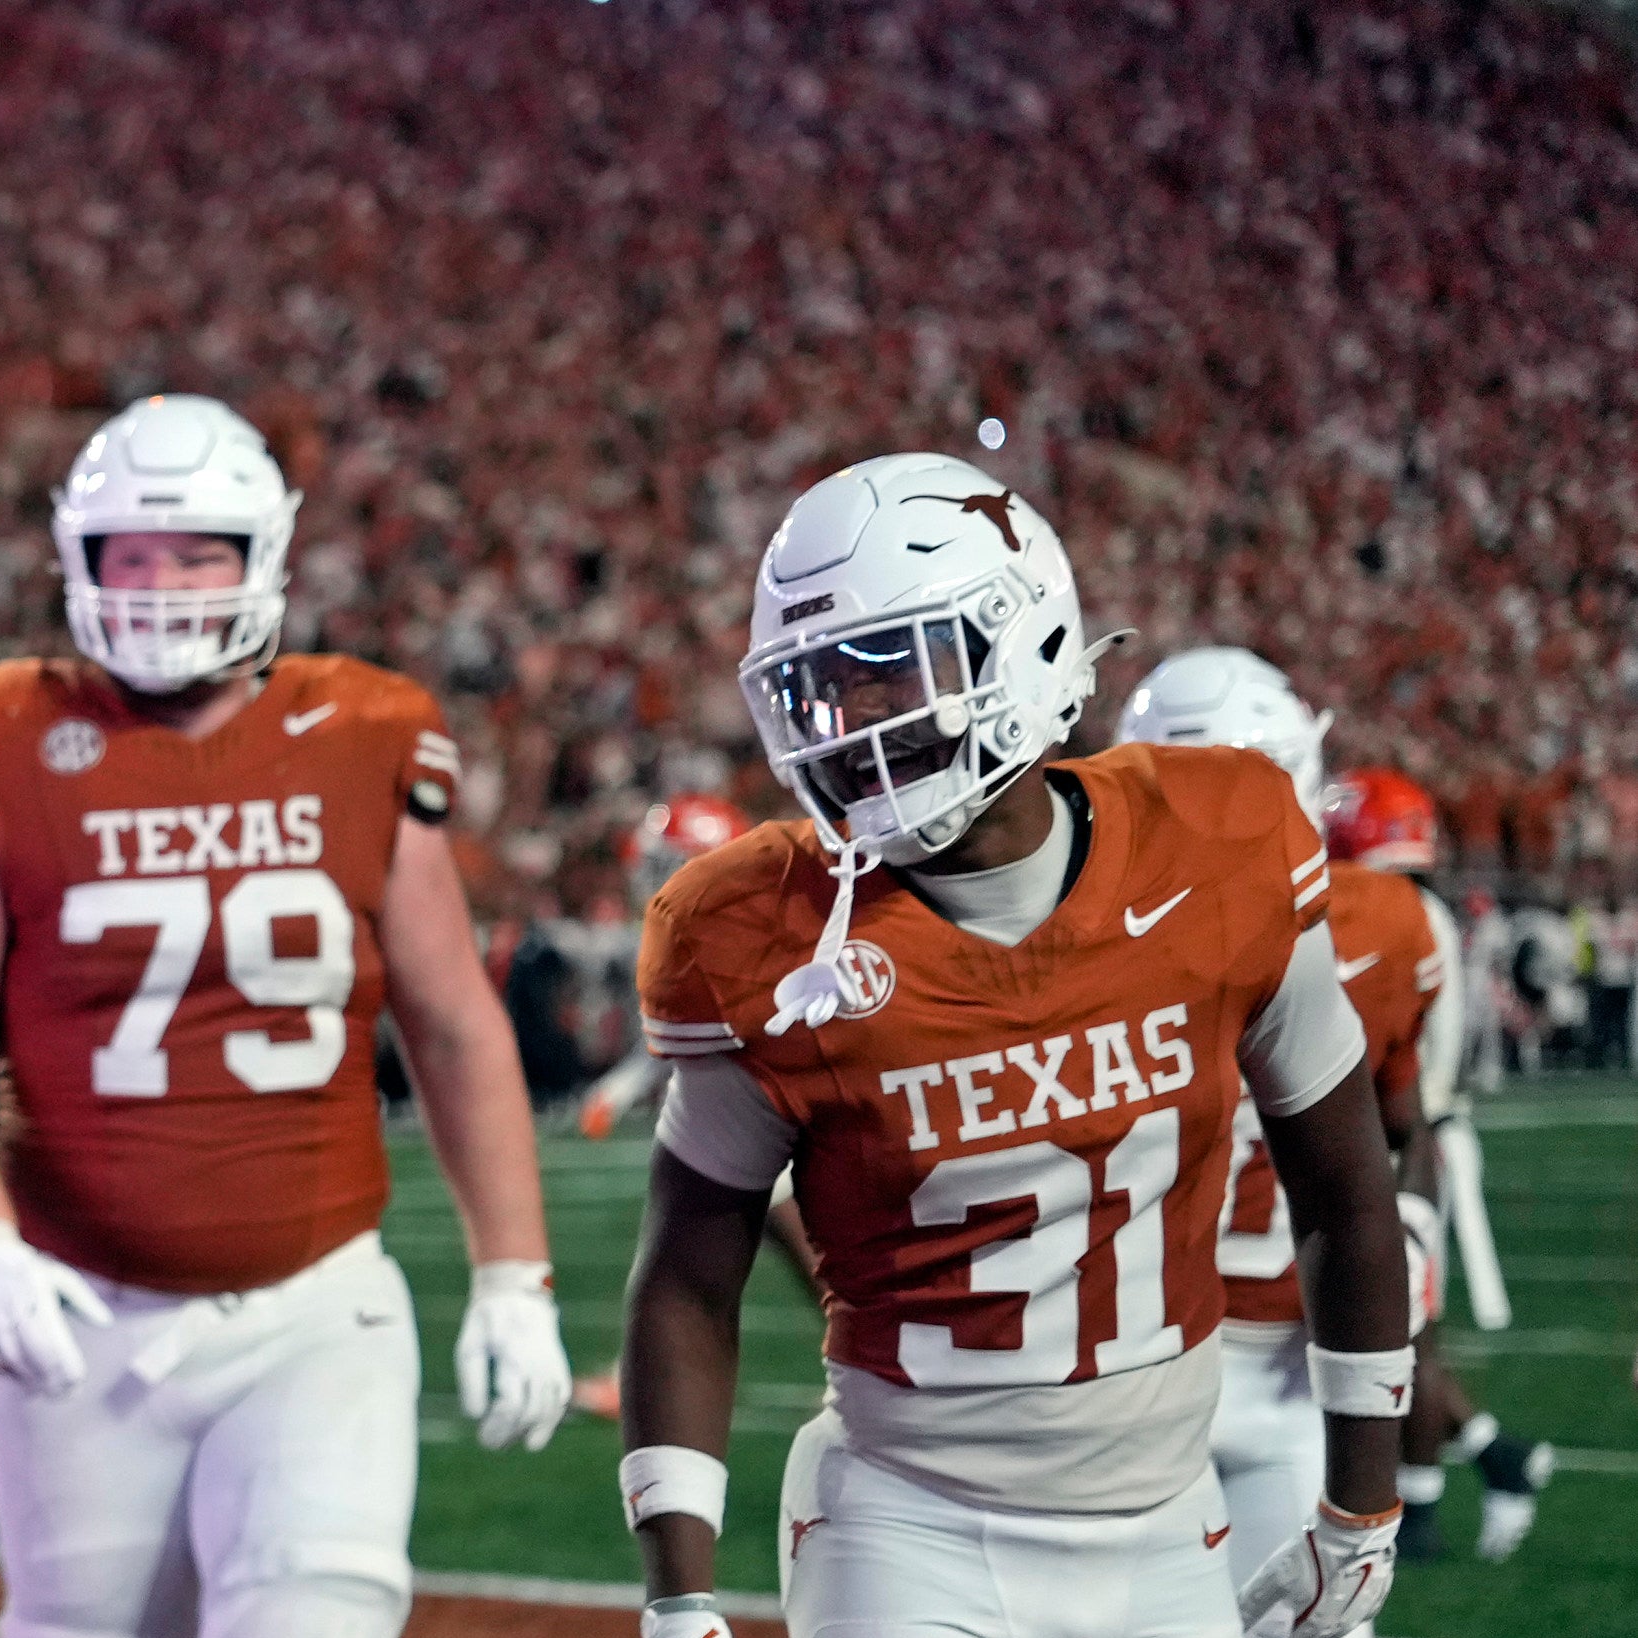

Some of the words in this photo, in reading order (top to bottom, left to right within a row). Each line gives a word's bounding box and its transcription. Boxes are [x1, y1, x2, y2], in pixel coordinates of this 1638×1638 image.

[82, 794, 324, 878] TEXAS
[59, 868, 357, 1099] 79
[836, 943, 891, 1012] EC
[879, 1002, 1196, 1152] TEXAS
[896, 1106, 1185, 1389] 31
